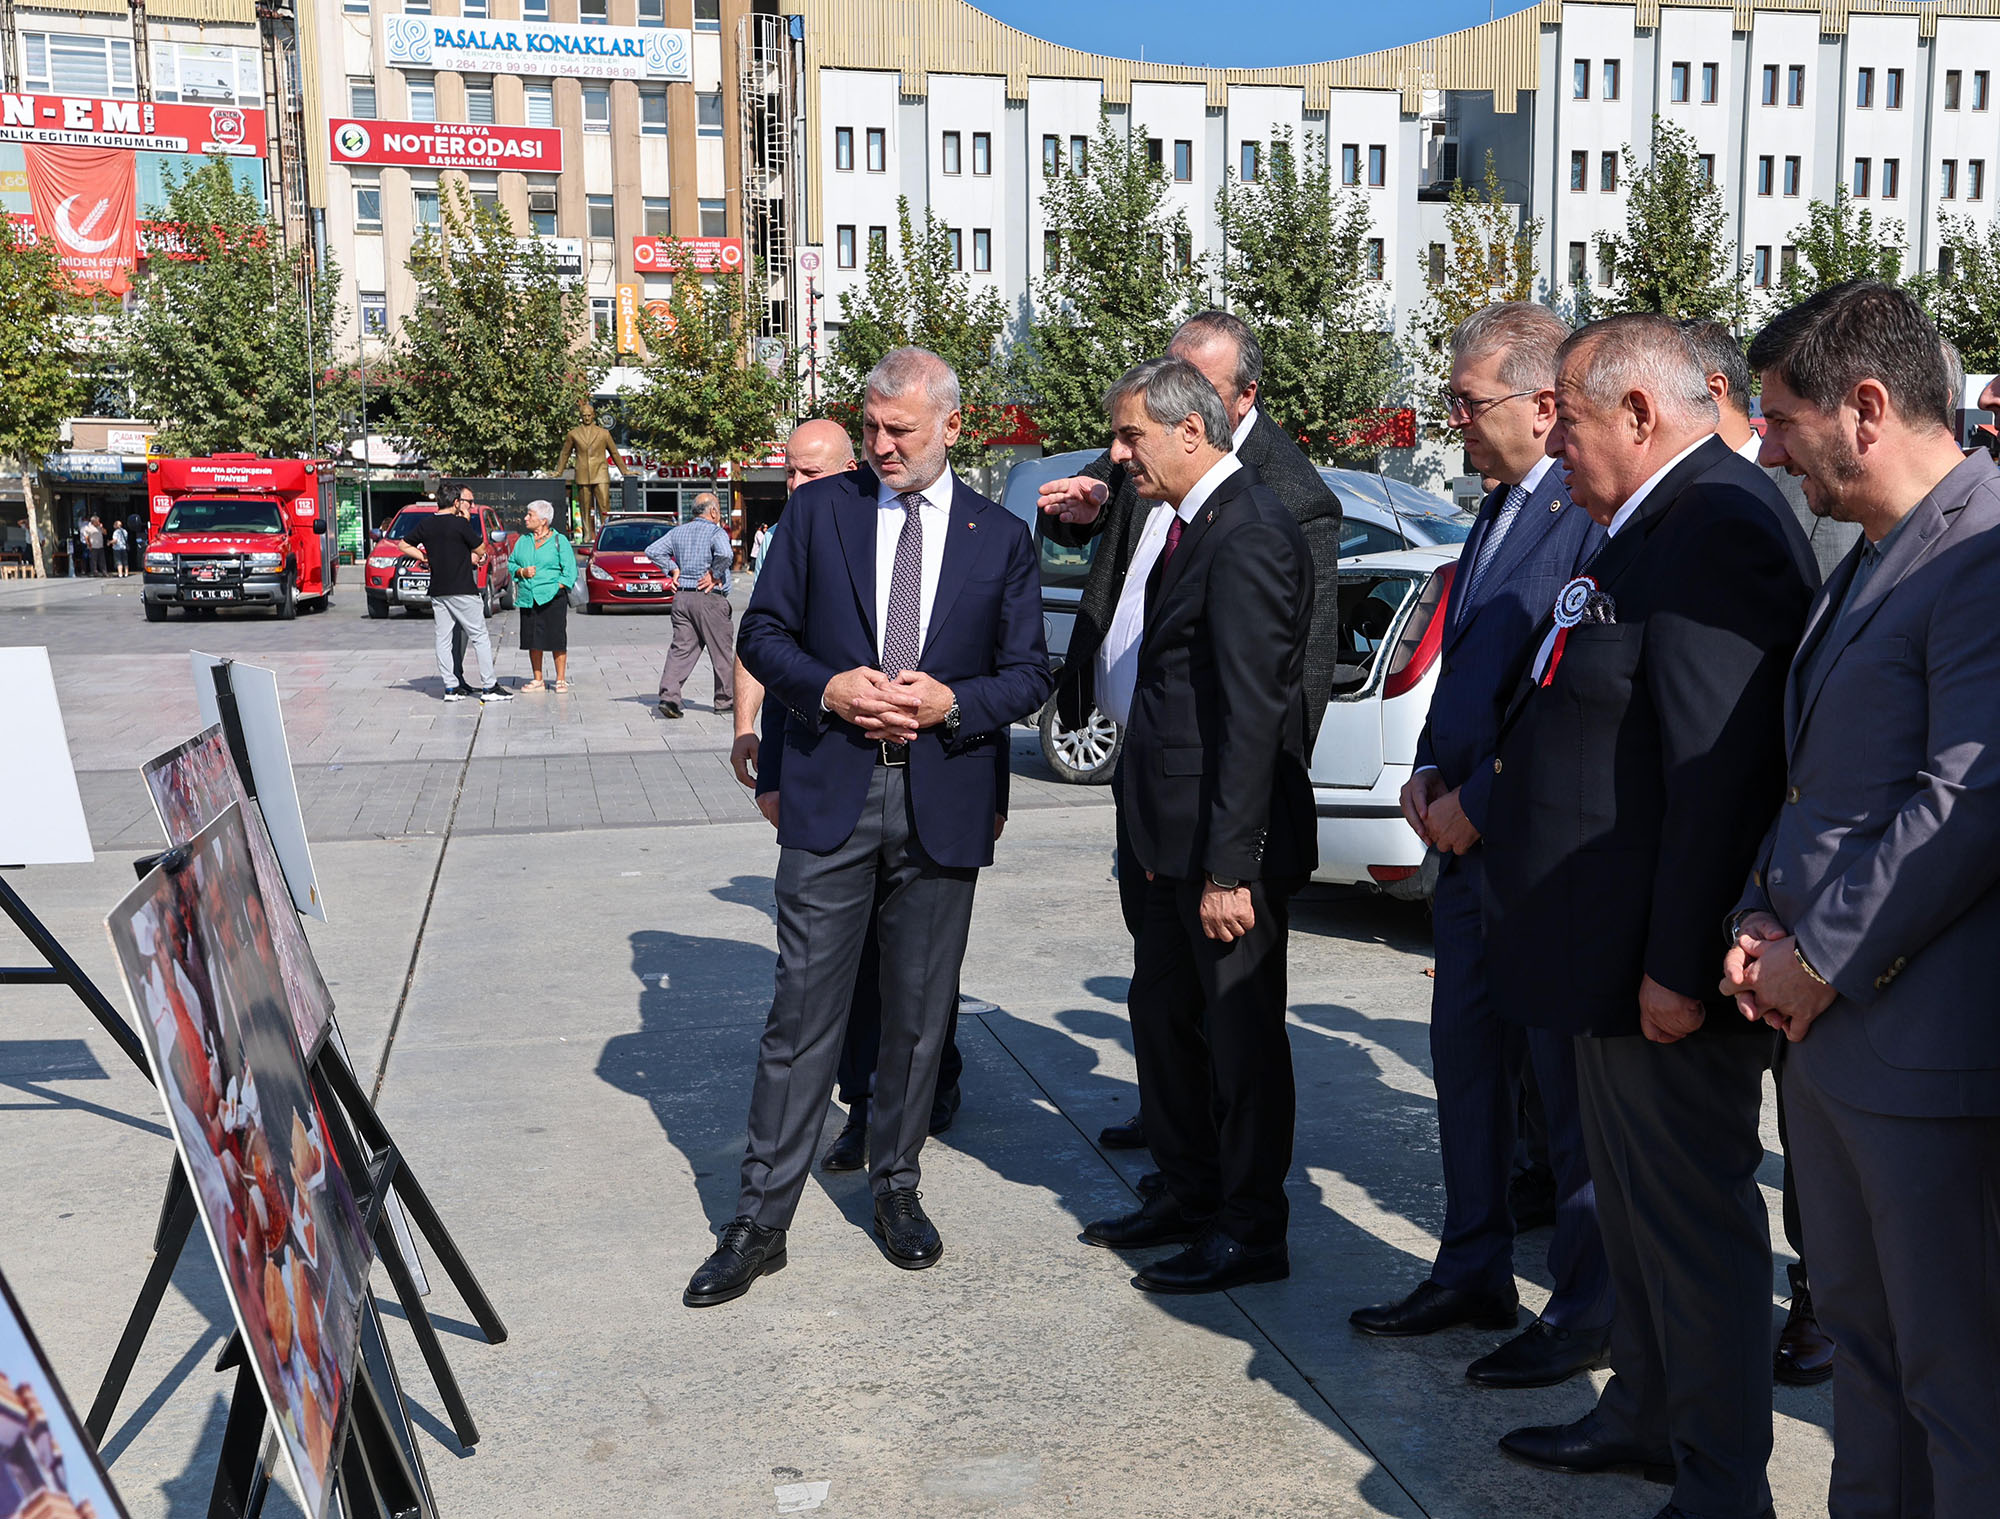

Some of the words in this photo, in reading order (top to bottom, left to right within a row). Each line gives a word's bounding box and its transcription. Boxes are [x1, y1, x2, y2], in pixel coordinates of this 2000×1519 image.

[434, 28, 522, 51] PAŞALAR
[526, 33, 645, 57] KONAKLARI
[461, 51, 492, 59] TERMAL
[495, 52, 515, 60] OTEL
[446, 59, 453, 68] 0
[456, 59, 476, 69] 264
[482, 60, 502, 70] 278
[506, 62, 520, 72] 99
[523, 63, 537, 72] 99
[551, 64, 558, 73] 0
[560, 64, 580, 74] 544
[583, 66, 603, 75] 278
[606, 67, 620, 76] 98
[623, 68, 636, 77] 99
[433, 124, 490, 136] SAKARYA
[94, 135, 179, 149] KURUMLARI
[383, 133, 467, 155] NOTER
[468, 137, 543, 158] ODASI
[428, 155, 497, 167] BAŞKANLIĞI
[57, 256, 97, 267] ENİDEN
[190, 466, 225, 474] SAKARYA
[226, 467, 273, 475] BÜYÜKŞEHİR
[657, 464, 729, 478] emlak
[104, 472, 137, 481] EMLAK
[214, 474, 249, 483] İTFAİYESİ
[156, 498, 170, 506] 112
[298, 501, 311, 509] 112
